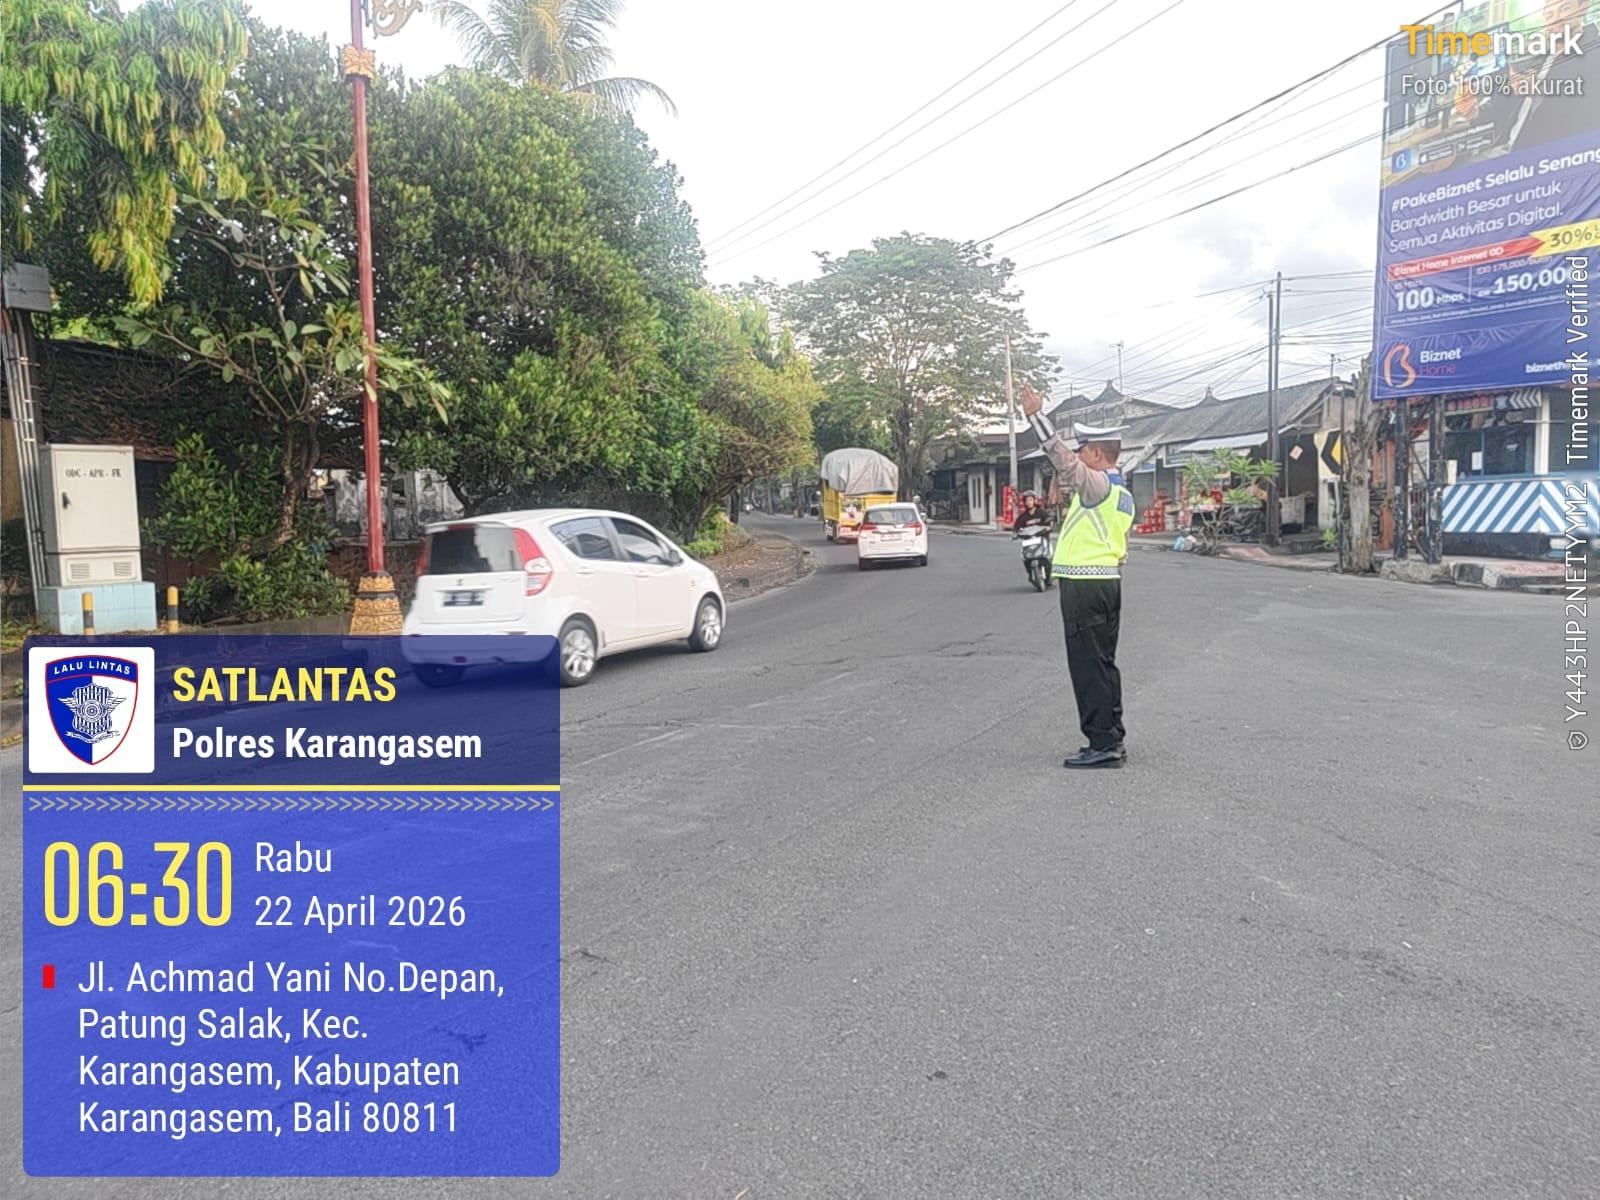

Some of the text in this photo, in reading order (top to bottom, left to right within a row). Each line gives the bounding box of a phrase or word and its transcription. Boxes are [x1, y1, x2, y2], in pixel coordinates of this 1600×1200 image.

[1392, 178, 1482, 212] #PakeBiznet
[1485, 166, 1534, 188] Selalu
[1390, 180, 1561, 233] Bandwidth Besar untuk
[1390, 201, 1564, 253] Semua Aktivitas Digital.
[1550, 226, 1592, 247] 30%
[1394, 265, 1420, 276] Biznet
[1423, 259, 1449, 270] Home
[1450, 250, 1488, 264] Internet
[1493, 266, 1575, 293] 150,00
[1395, 287, 1435, 313] 100
[1436, 293, 1465, 305] Mbps
[1420, 348, 1461, 364] Biznet
[1421, 364, 1456, 376] Home
